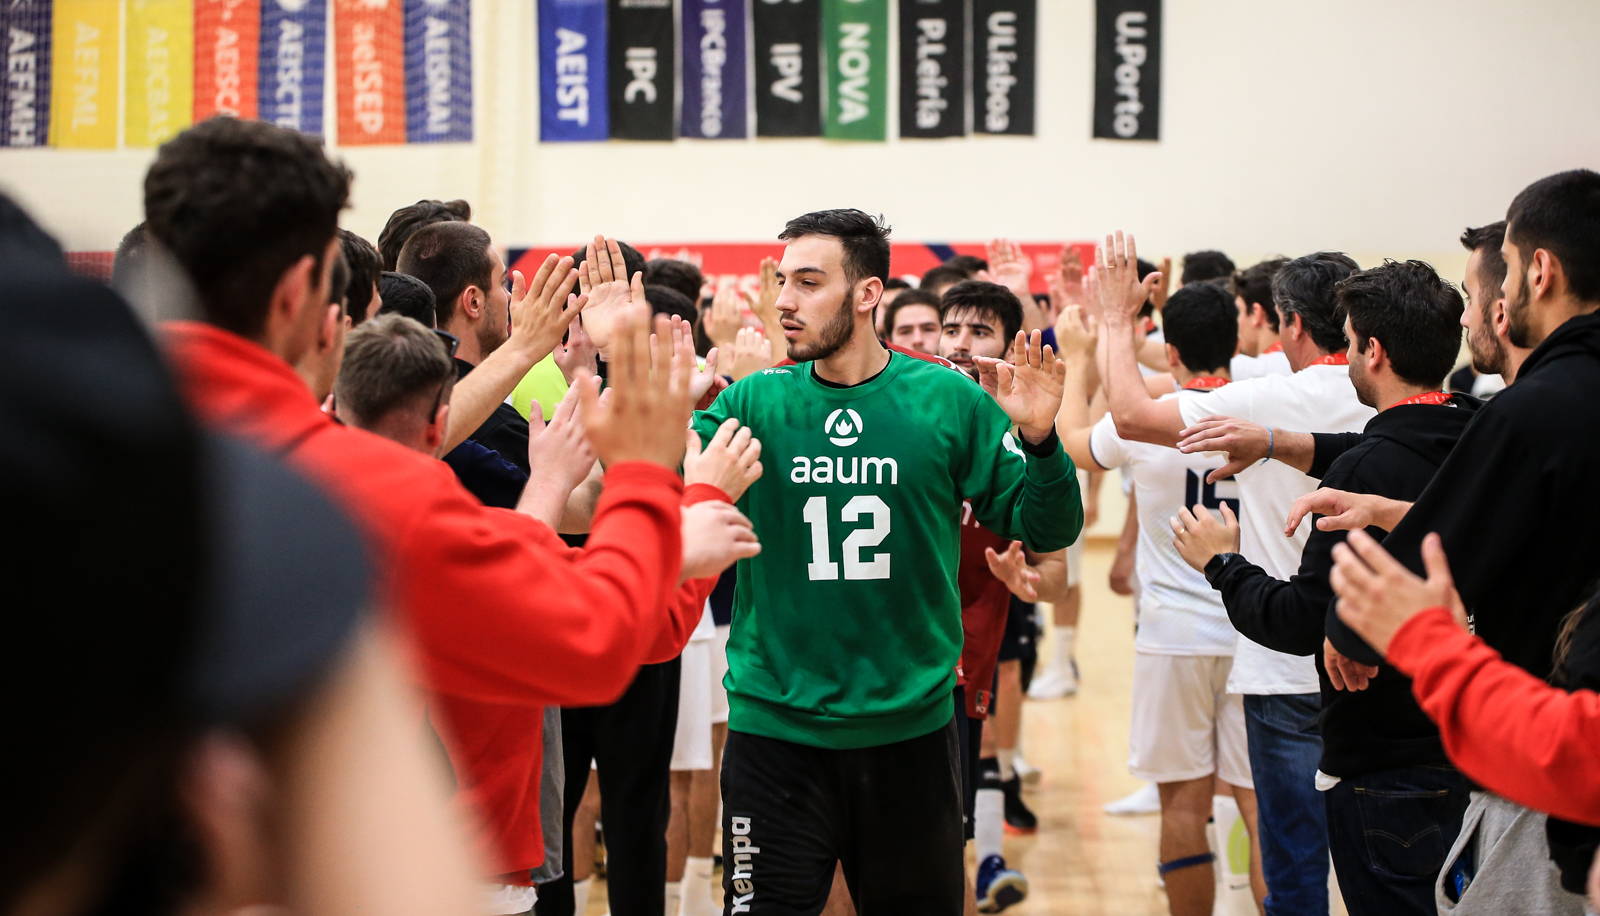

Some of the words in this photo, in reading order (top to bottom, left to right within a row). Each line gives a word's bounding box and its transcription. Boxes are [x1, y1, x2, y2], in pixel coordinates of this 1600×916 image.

[72, 22, 100, 132] AEFML
[555, 27, 589, 126] AEIST
[624, 47, 657, 103] IPC
[770, 44, 803, 102] IPV
[838, 22, 871, 124] NOVA
[916, 18, 948, 129] P.Leiria
[985, 11, 1017, 132] ULisboa
[1113, 11, 1147, 138] U.Porto
[790, 456, 898, 485] aaum
[802, 495, 891, 581] 12
